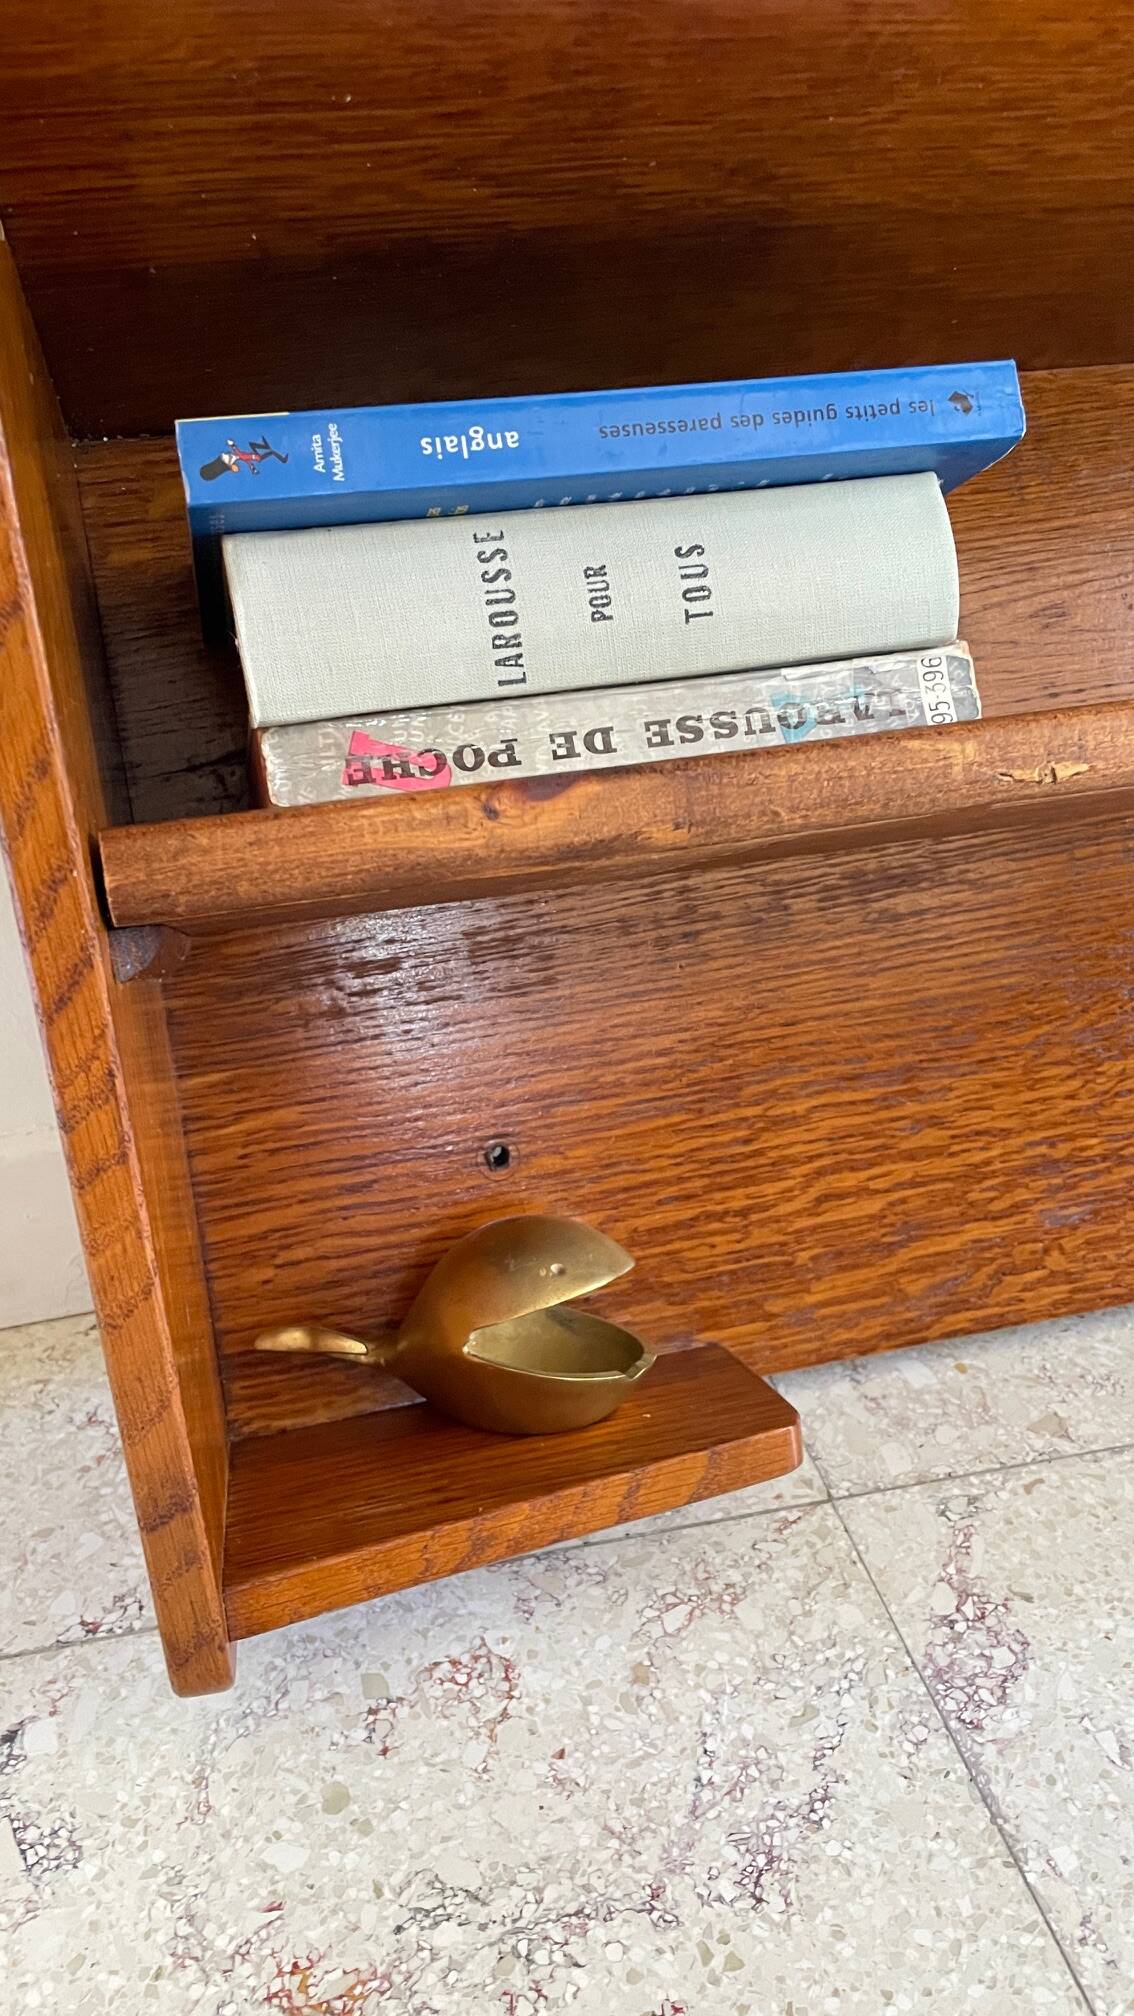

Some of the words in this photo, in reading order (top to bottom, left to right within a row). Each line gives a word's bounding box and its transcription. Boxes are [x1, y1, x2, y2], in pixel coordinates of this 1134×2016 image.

[731, 408, 764, 429] des
[772, 403, 838, 427] guides
[845, 397, 901, 420] petits
[909, 398, 936, 416] les
[420, 426, 520, 459] anglais
[599, 413, 722, 439] paresseuses
[310, 433, 326, 473] Amita
[327, 423, 345, 482] Mukerjee
[583, 564, 614, 623] POUR
[674, 543, 714, 625] TOUS
[473, 530, 527, 687] LAROUSSE
[922, 655, 954, 726] 95-396
[345, 738, 523, 786] POCHE
[548, 726, 618, 761] DE
